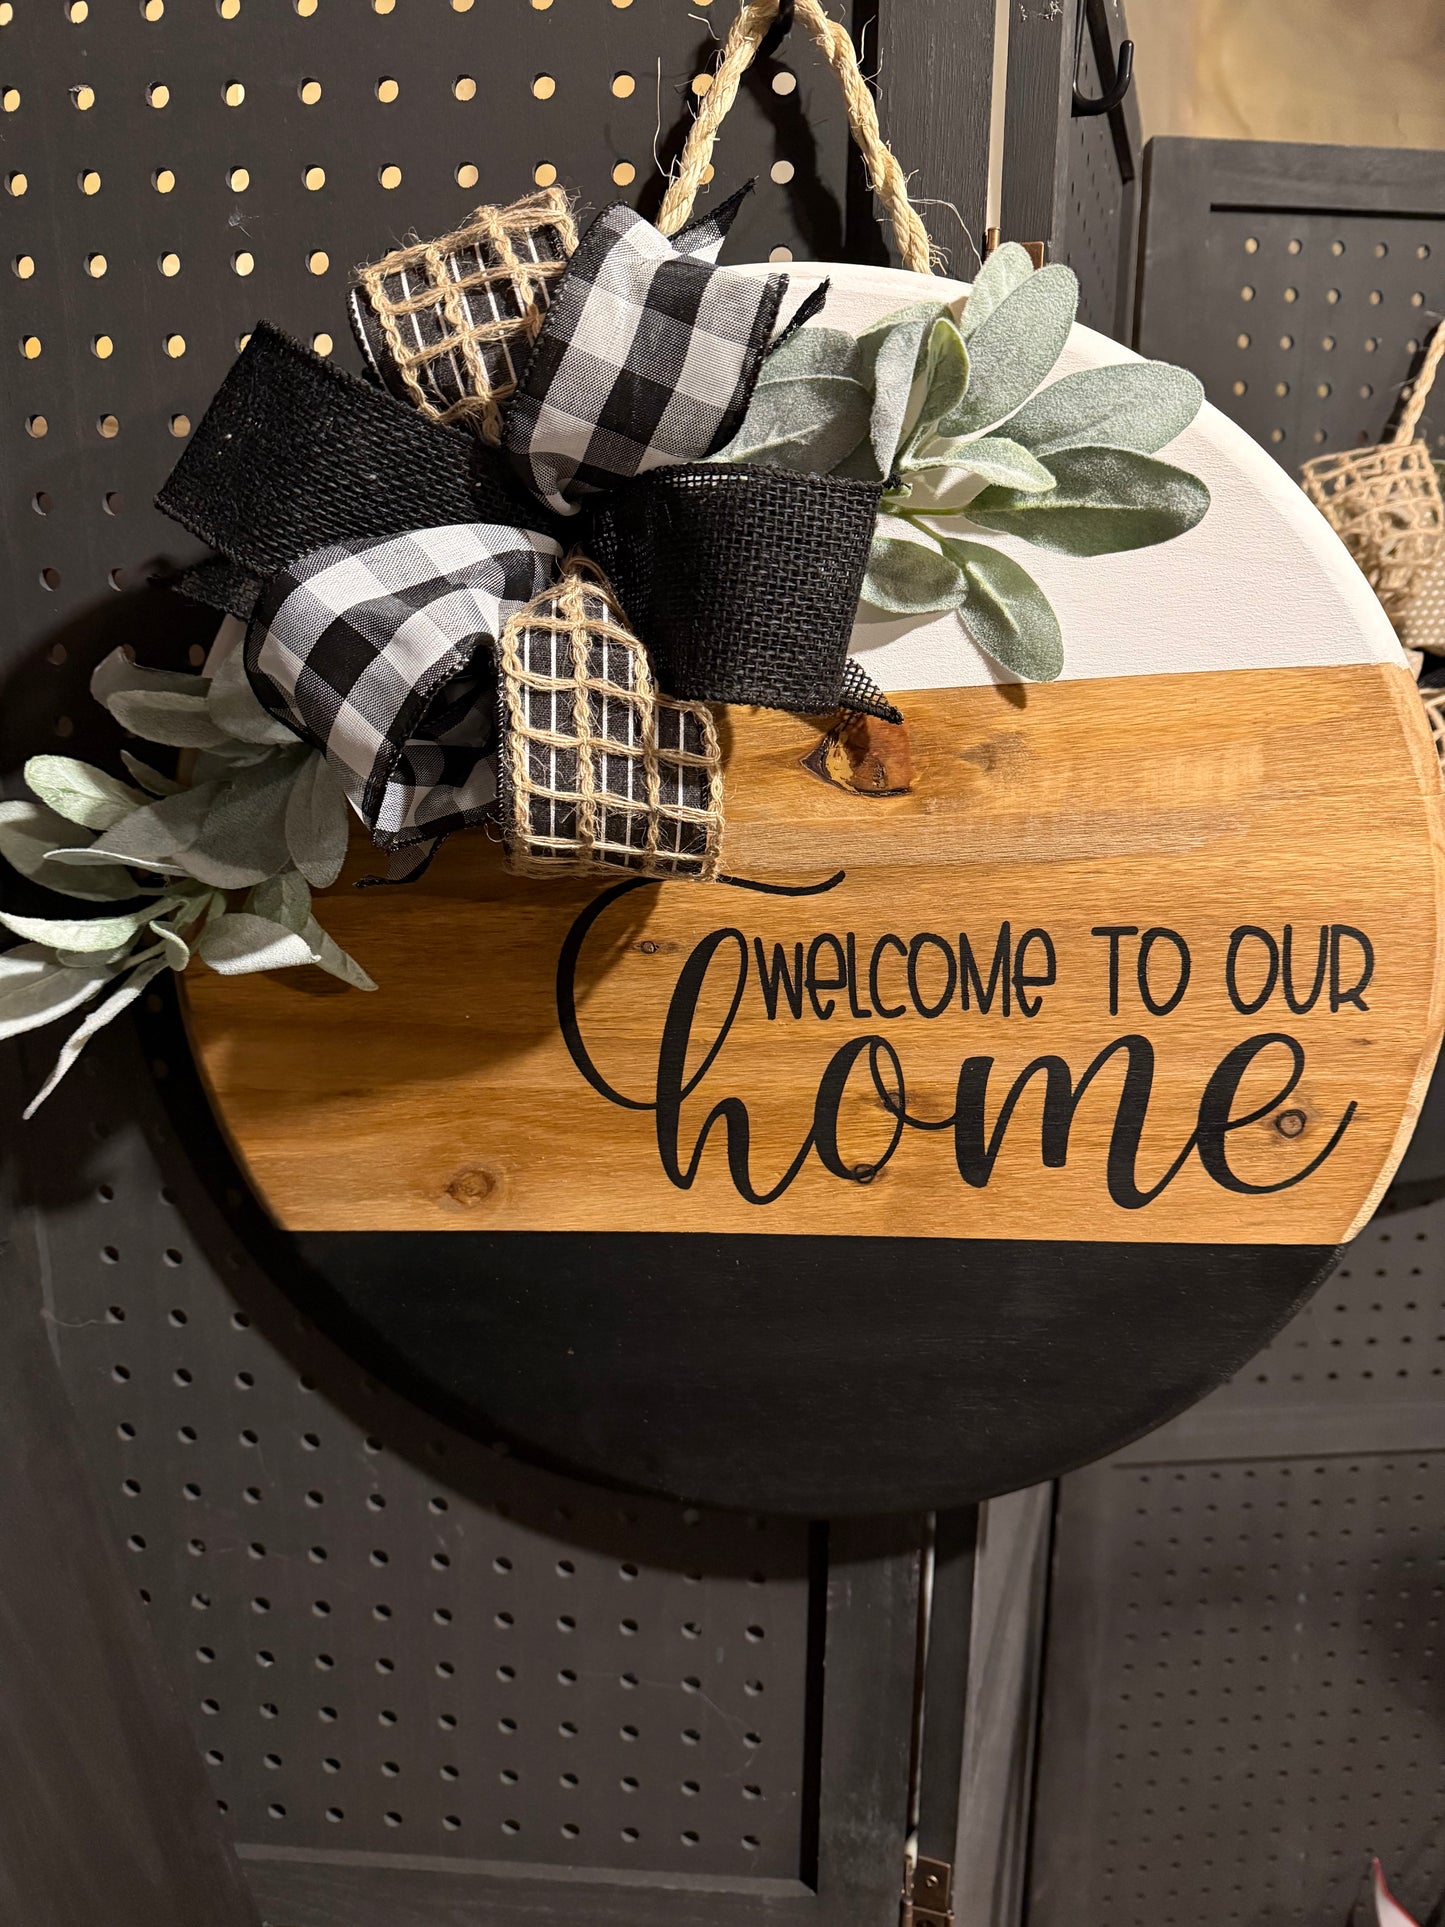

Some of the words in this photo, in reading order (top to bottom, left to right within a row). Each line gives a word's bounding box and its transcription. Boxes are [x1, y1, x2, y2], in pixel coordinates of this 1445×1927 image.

[556, 870, 1358, 1210] home
[1091, 926, 1192, 1017] TO
[1226, 924, 1375, 1015] OUR
